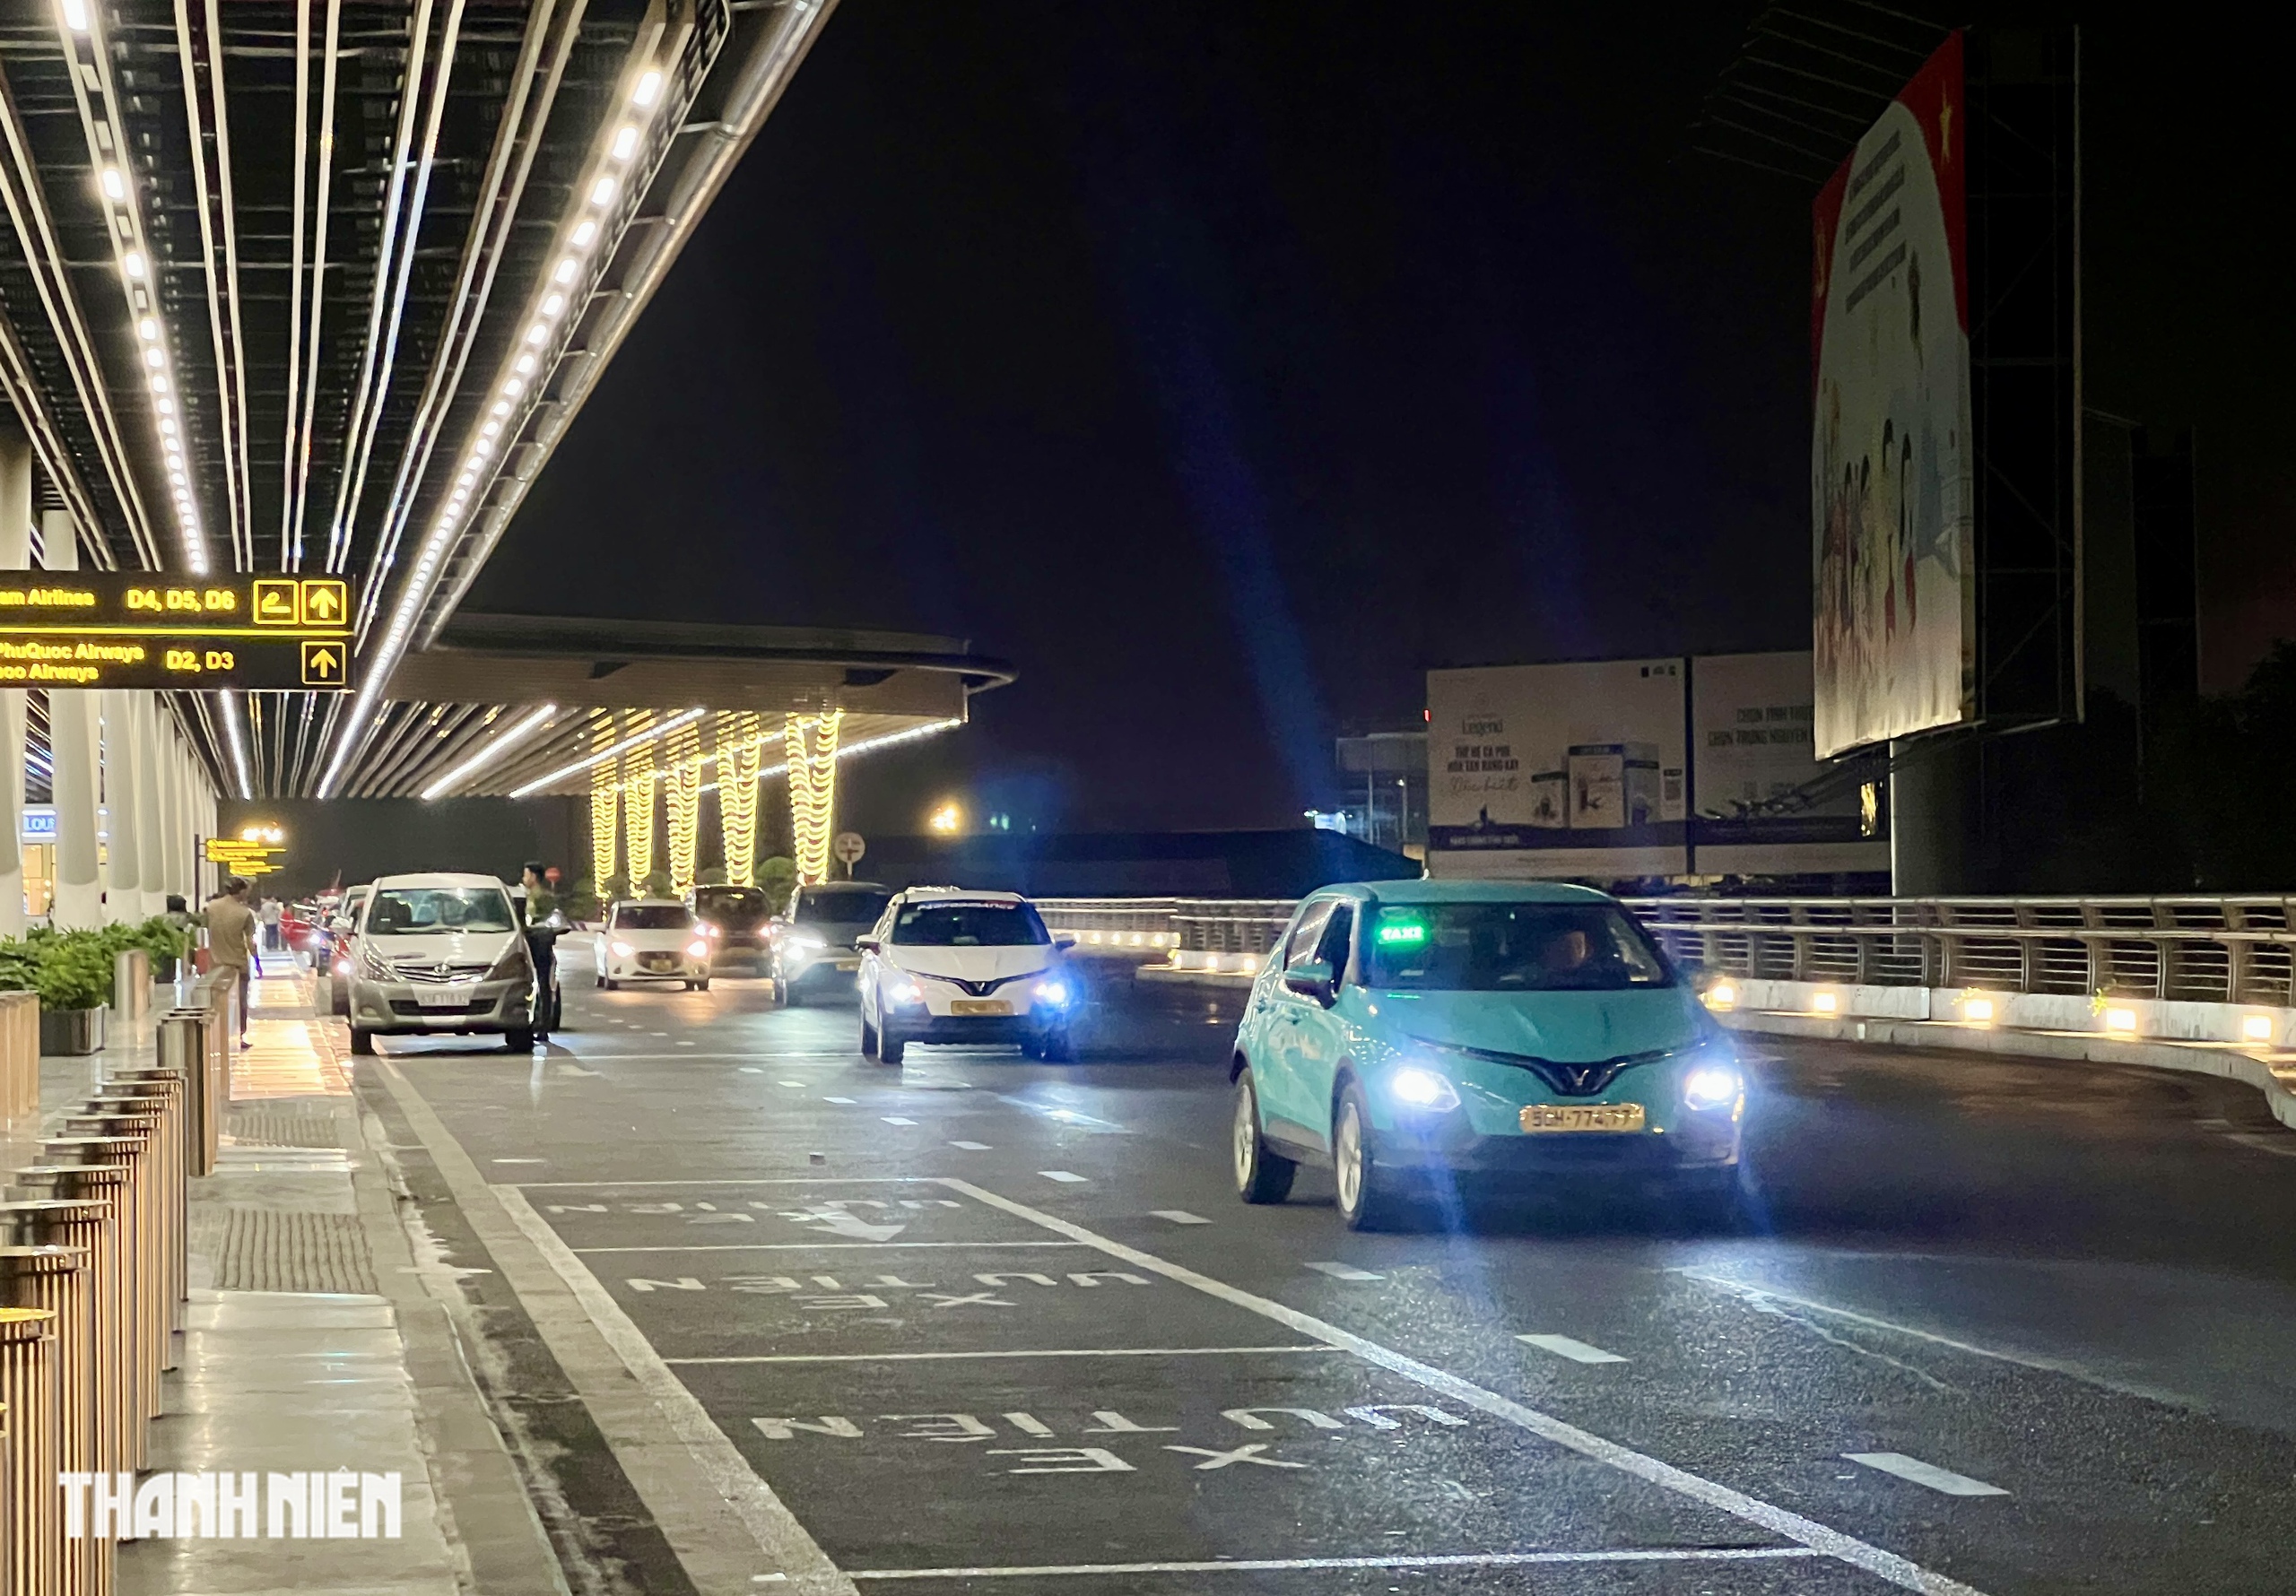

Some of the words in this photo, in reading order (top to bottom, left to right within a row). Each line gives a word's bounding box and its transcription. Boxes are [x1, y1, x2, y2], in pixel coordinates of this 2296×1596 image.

[28, 588, 95, 605] Airlines
[126, 589, 162, 612] D4,
[166, 589, 202, 612] D5,
[204, 590, 235, 610] D6
[74, 643, 144, 663] Airways
[166, 650, 201, 672] D2,
[205, 651, 234, 670] D3
[29, 664, 99, 682] Airways
[1380, 926, 1422, 941] TAXI
[791, 1293, 1018, 1310] XE
[987, 1444, 1309, 1474] XE
